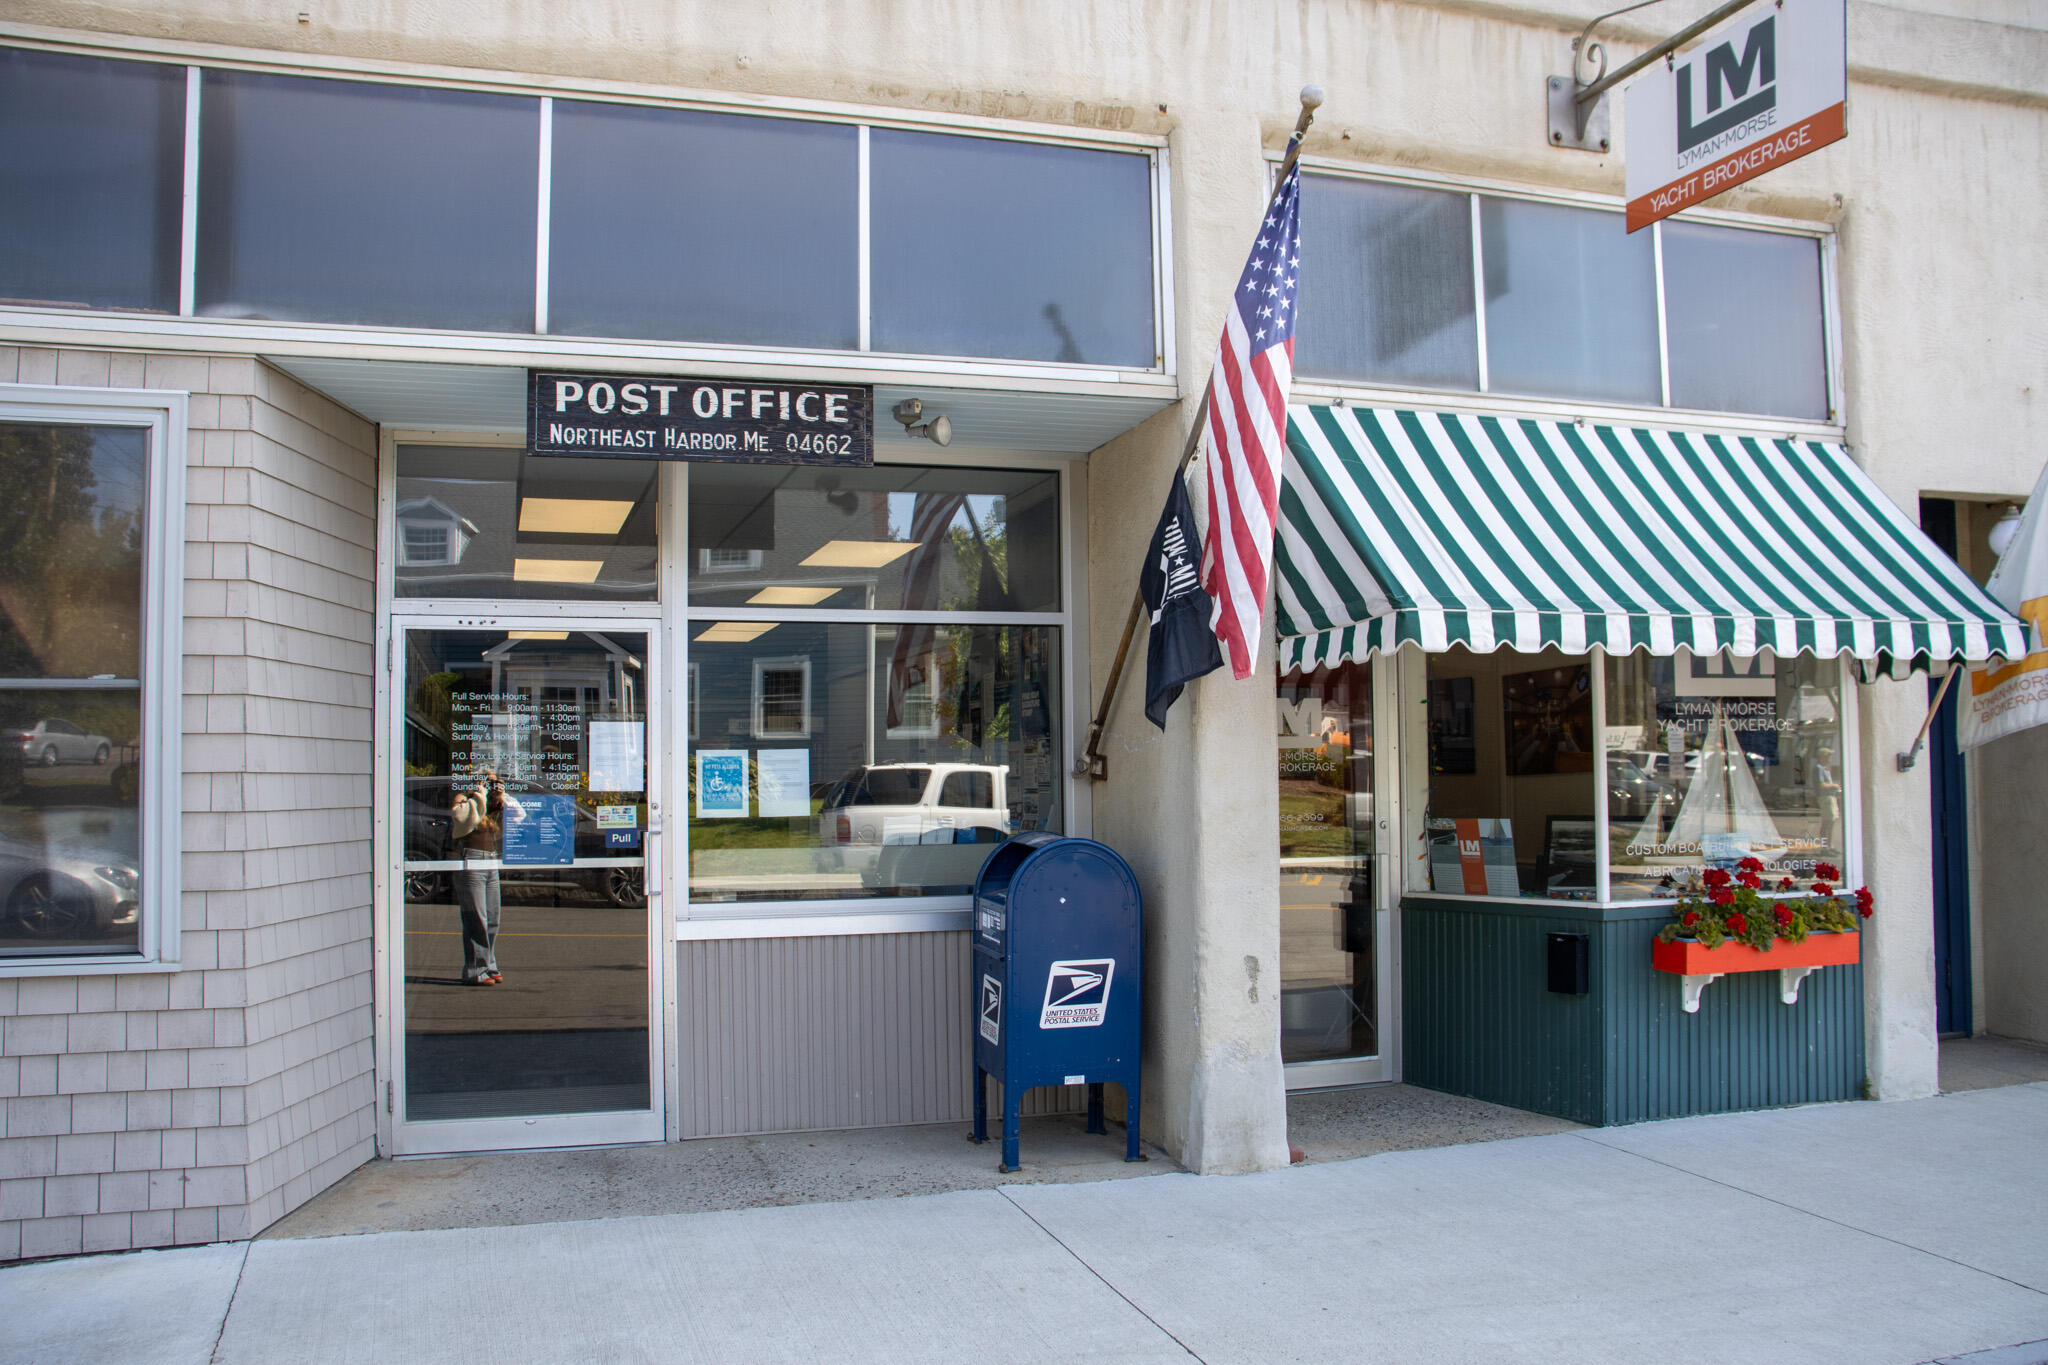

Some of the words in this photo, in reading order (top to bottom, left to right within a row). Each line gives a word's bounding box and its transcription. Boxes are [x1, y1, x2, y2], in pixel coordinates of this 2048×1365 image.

[1677, 15, 1776, 154] LM
[1677, 108, 1777, 170] LYMAN-MORSE
[1650, 176, 1699, 213] YACHT
[1703, 124, 1811, 190] BROKERAGE
[555, 381, 678, 415] POST
[692, 386, 849, 423] OFFICE
[786, 433, 853, 455] 04662
[452, 692, 467, 701] Full
[469, 692, 500, 701] Service
[502, 692, 530, 701] Hours:
[452, 704, 472, 712] Mon.
[507, 704, 538, 712] 9:00am
[546, 704, 580, 712] 11:30am
[1675, 703, 1776, 715] LYMAN-MORSE
[551, 714, 580, 722] 4:00pm
[452, 723, 488, 732] Saturday
[546, 723, 580, 731] 11:30am
[1657, 718, 1705, 731] YACHT
[1708, 718, 1795, 731] BROKERAGE
[452, 733, 483, 742] Sunday
[485, 733, 491, 741] &
[552, 733, 580, 741] Closed
[452, 752, 468, 760] P.O.
[470, 752, 486, 760] Box
[516, 752, 545, 760] Service
[547, 752, 575, 760] Hours:
[1279, 752, 1323, 761] -MORSE
[549, 763, 579, 772] 4:15pm
[1279, 762, 1337, 772] ROKERAGE
[452, 773, 488, 782] Saturday
[546, 773, 579, 782] 12:00pm
[494, 783, 529, 792] Holidays
[612, 833, 631, 843] Pull
[1460, 840, 1480, 855] LM
[1626, 843, 1676, 856] CUSTOM
[1780, 837, 1829, 849] SERVICE
[1763, 860, 1817, 871] NOLOGIES
[1044, 1017, 1070, 1025] POSTAL
